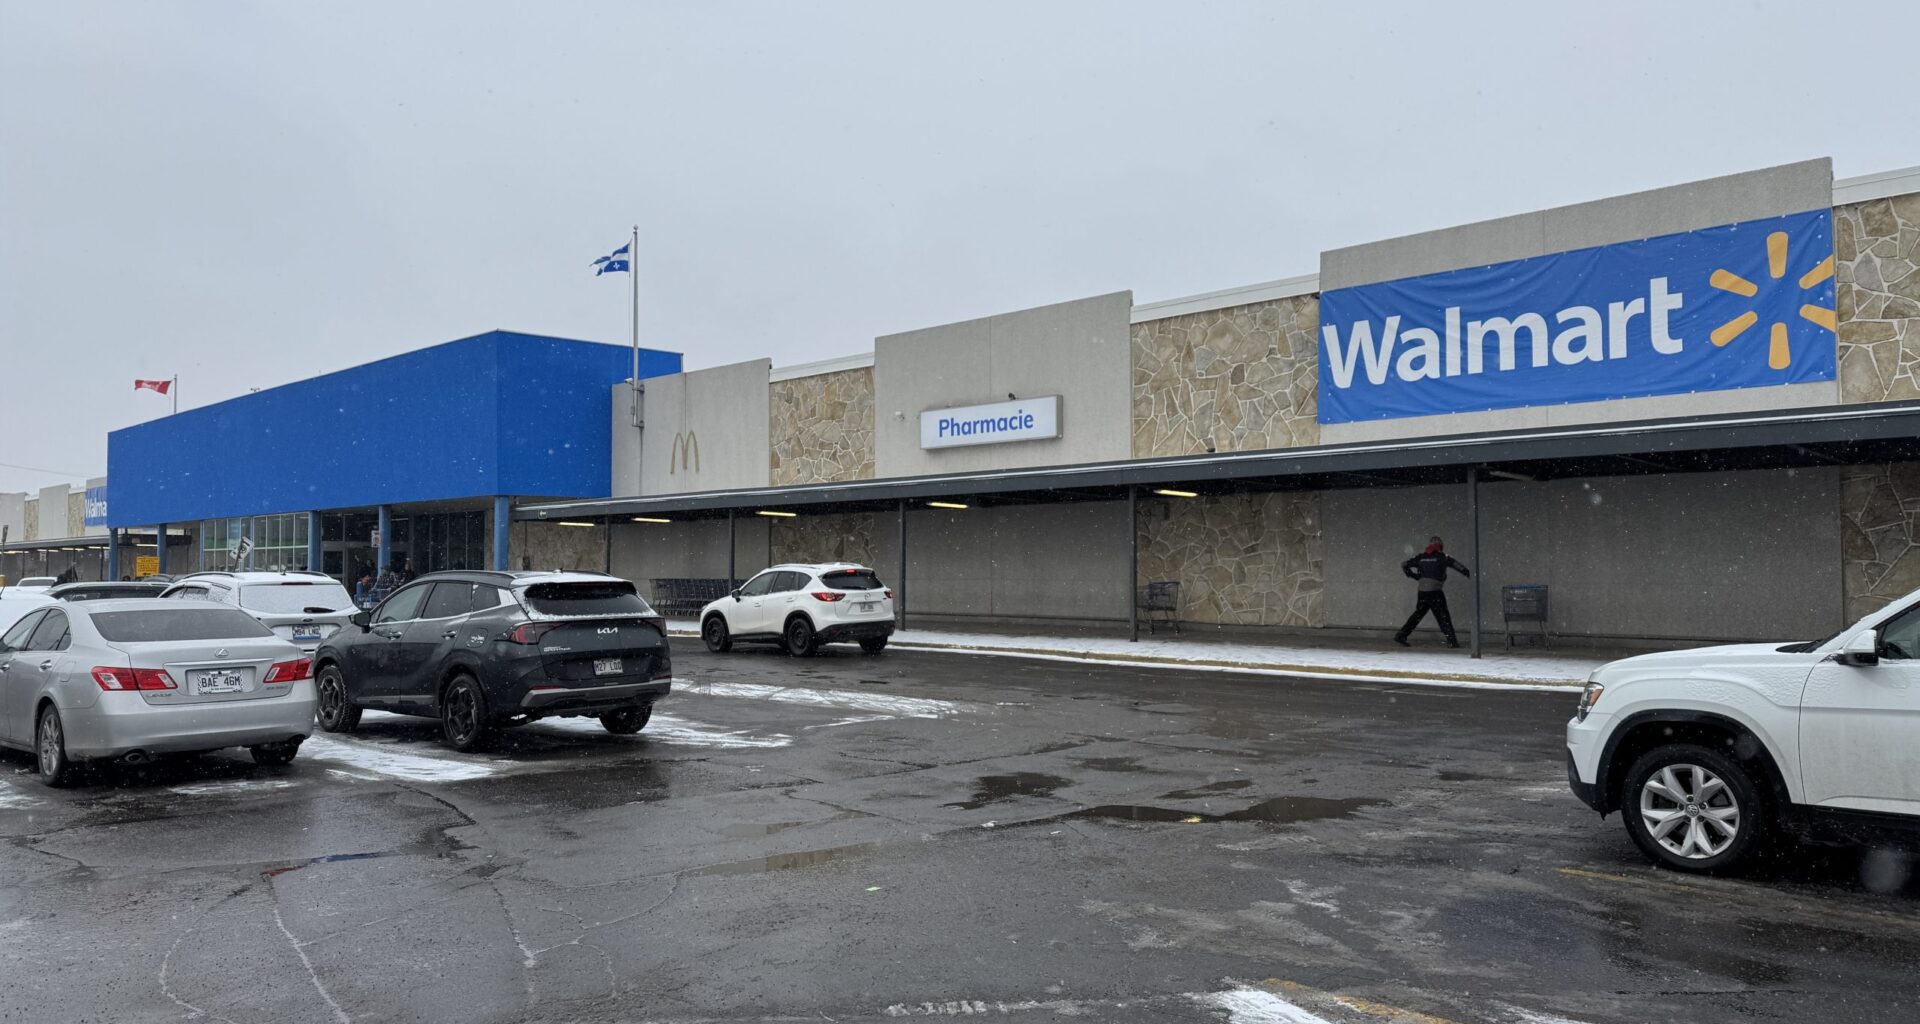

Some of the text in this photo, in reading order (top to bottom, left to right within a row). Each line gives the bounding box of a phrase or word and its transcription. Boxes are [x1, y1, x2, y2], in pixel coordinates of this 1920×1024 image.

[1322, 276, 1684, 389] Walmart
[939, 409, 1034, 438] Pharmacie
[201, 675, 241, 688] BAE 46M
